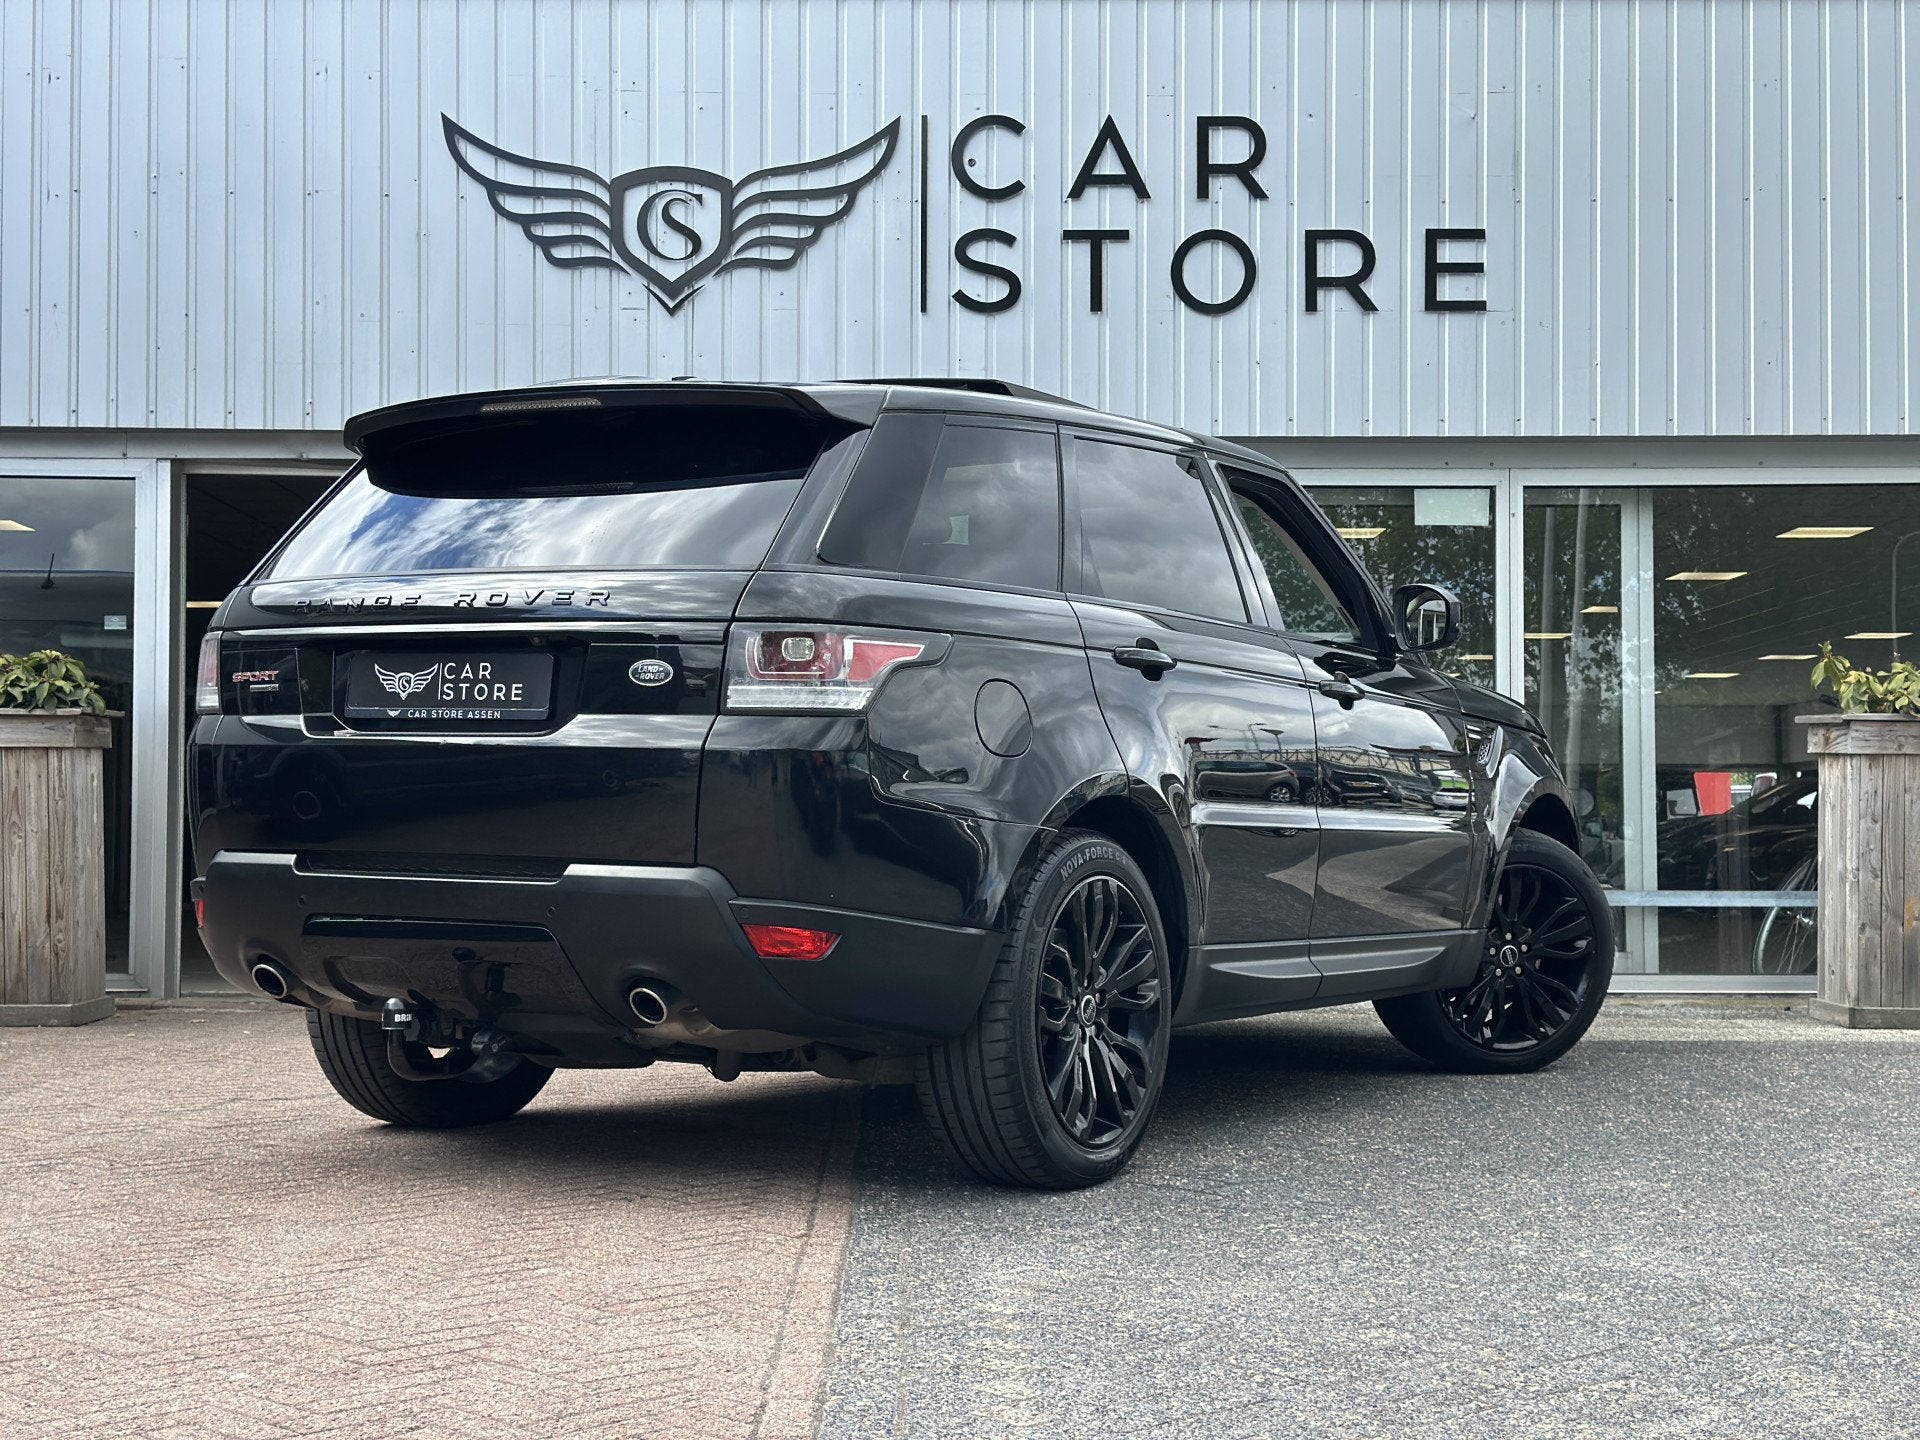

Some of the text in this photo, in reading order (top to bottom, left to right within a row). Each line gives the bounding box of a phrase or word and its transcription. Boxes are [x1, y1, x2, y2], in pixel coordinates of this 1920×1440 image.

[951, 114, 1269, 201] CAR
[951, 228, 1487, 316] STORE
[293, 588, 611, 614] RANGE ROVER
[232, 670, 279, 682] SPORT
[444, 662, 492, 680] CAR
[638, 664, 659, 673] LAND
[640, 672, 665, 680] ROVER
[442, 682, 524, 701] STORE
[407, 709, 501, 719] CAR STORE ASSEN
